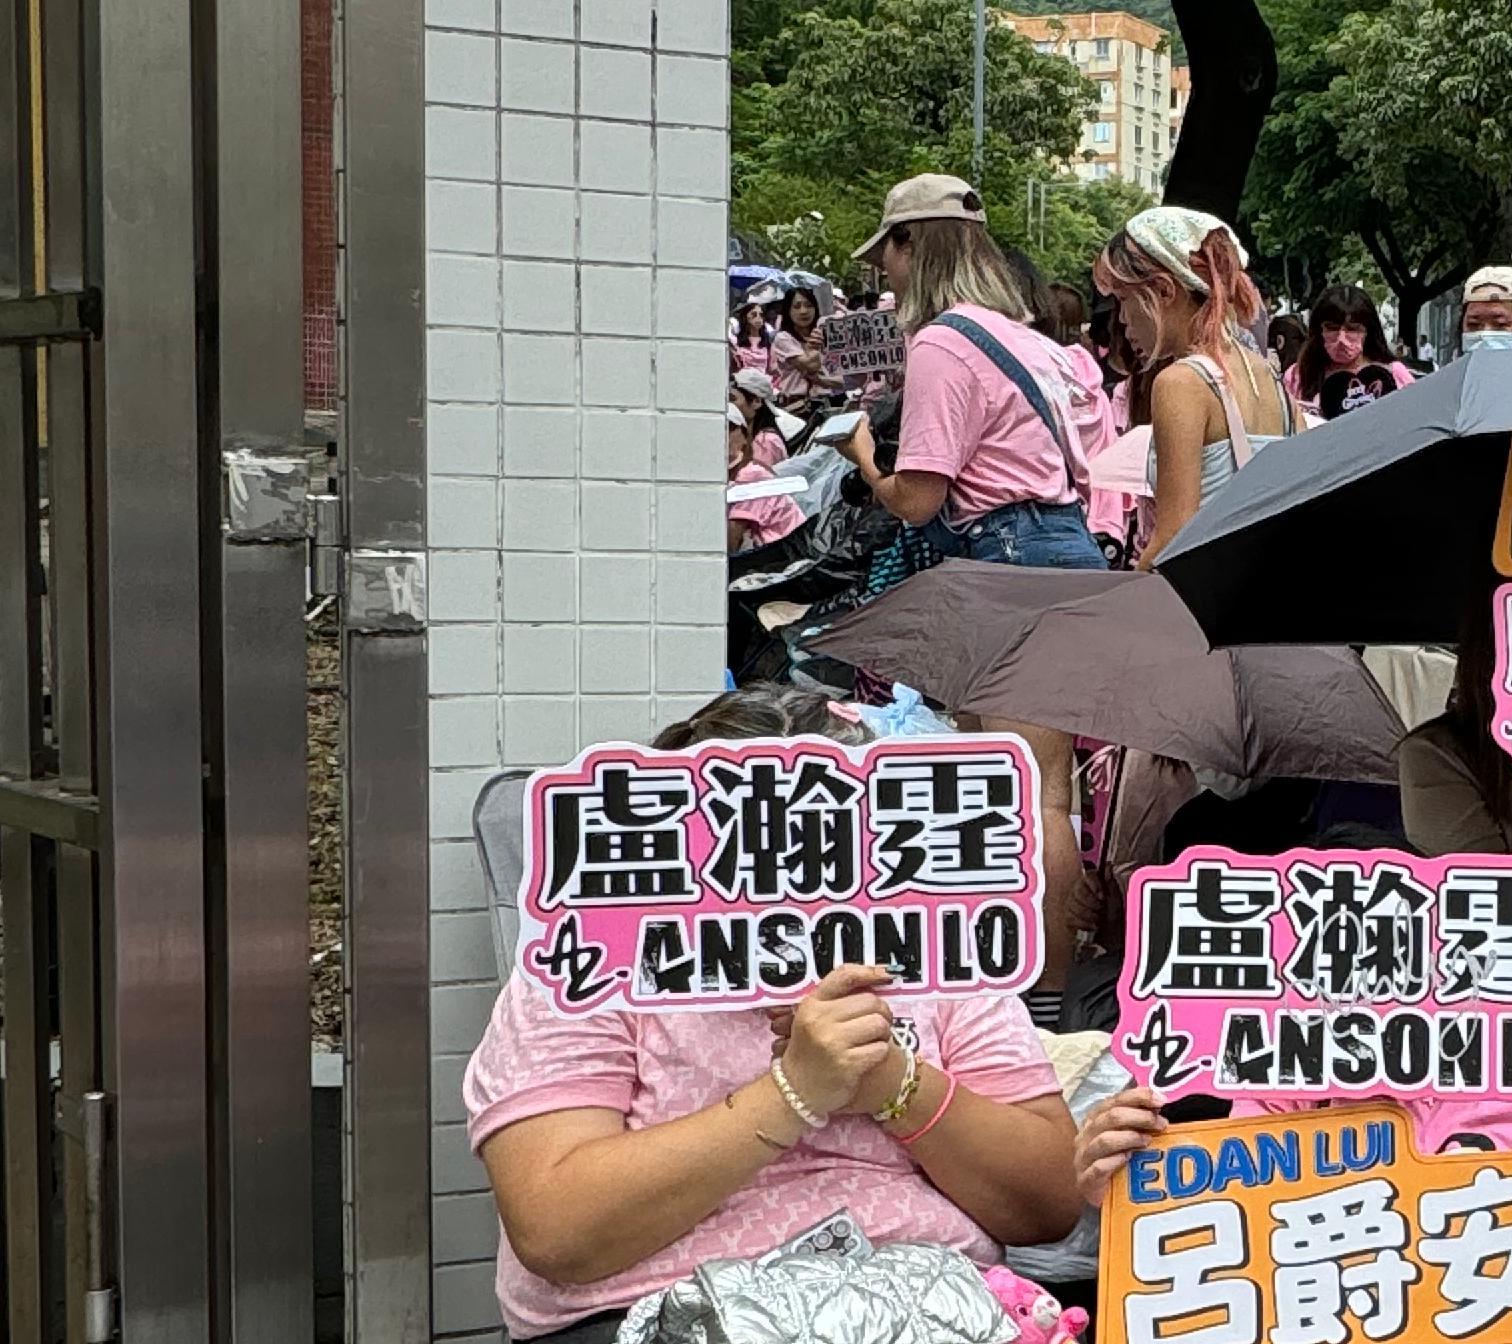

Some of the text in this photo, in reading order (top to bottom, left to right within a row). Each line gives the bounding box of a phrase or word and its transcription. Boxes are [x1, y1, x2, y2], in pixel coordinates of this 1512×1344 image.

[547, 760, 1020, 904] 盧瀚霆
[640, 910, 922, 994] ANSON
[943, 906, 1020, 982] LO
[1219, 1012, 1484, 1086] ANSON
[1129, 1121, 1396, 1203] EDAN LUI
